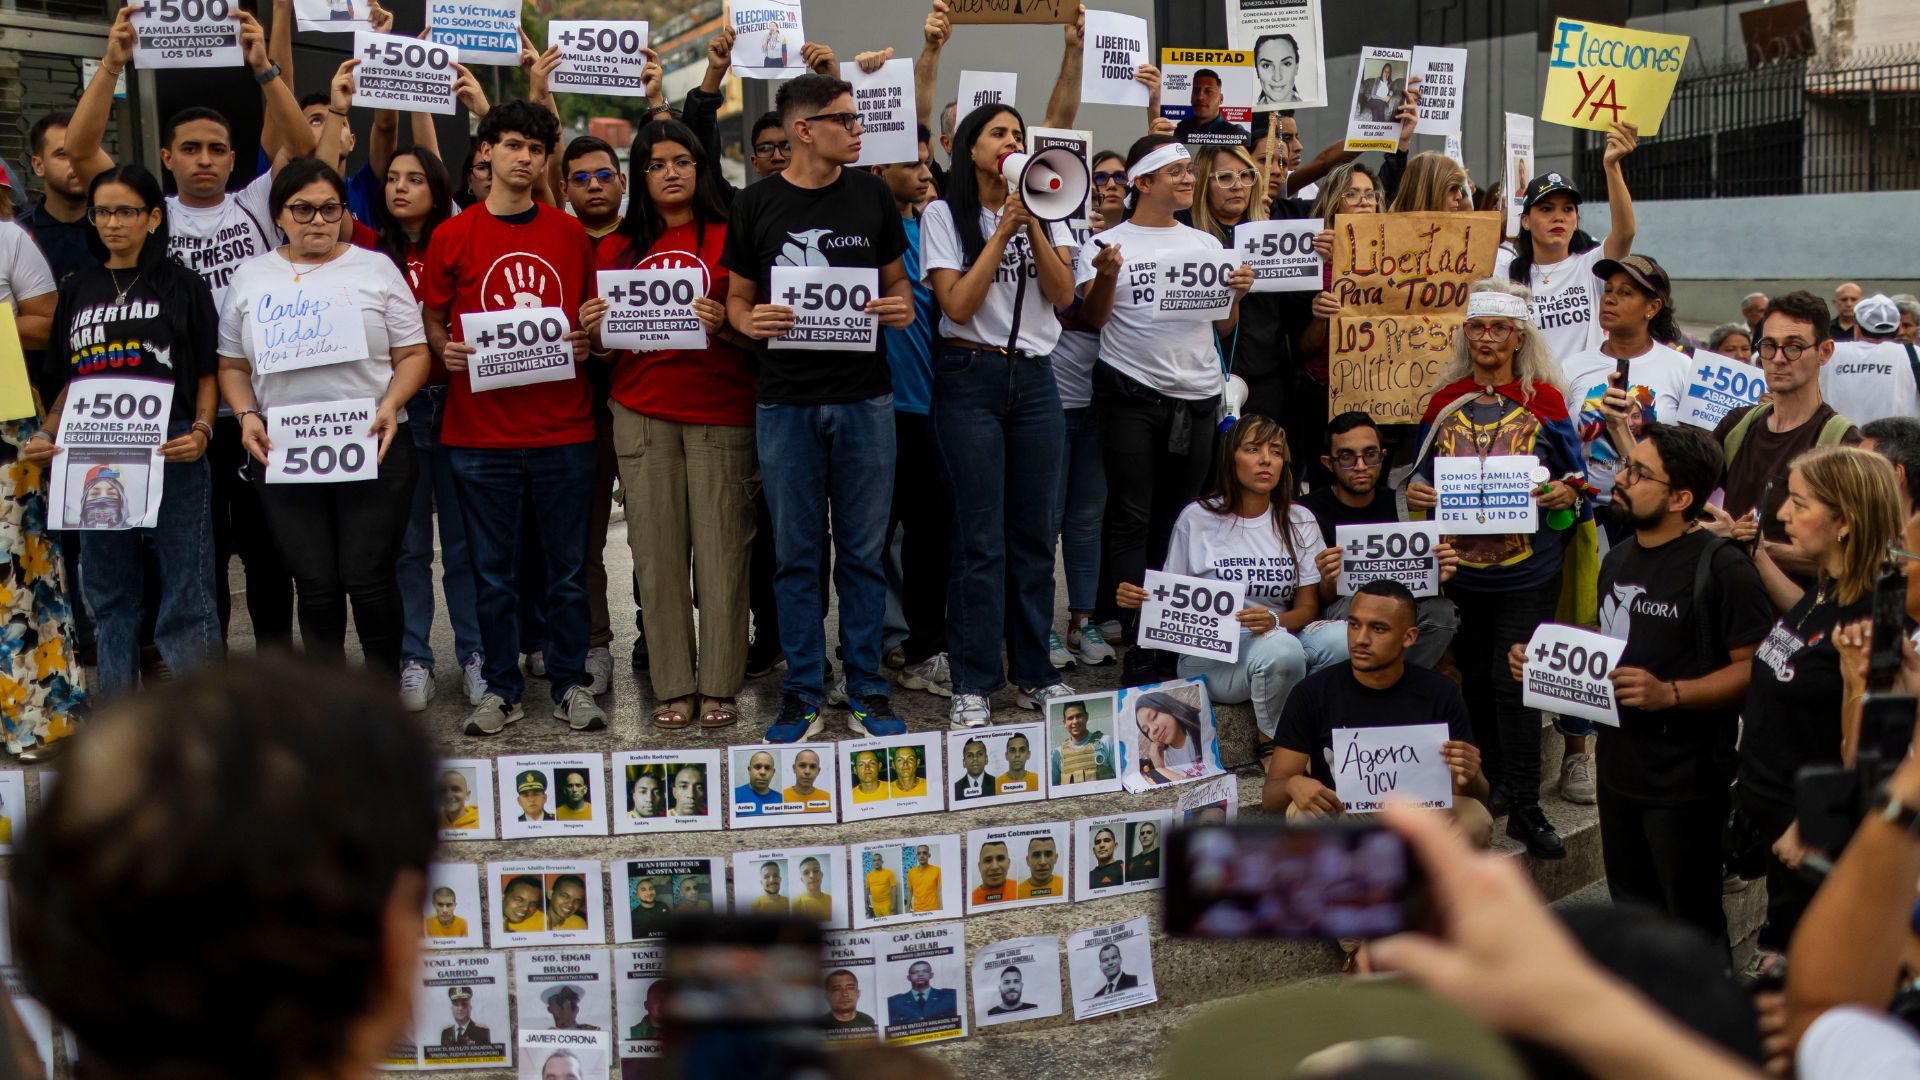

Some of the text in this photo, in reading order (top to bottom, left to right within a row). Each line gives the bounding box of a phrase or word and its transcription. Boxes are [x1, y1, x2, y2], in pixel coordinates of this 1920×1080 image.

[432, 4, 456, 15] LAS
[432, 16, 517, 31] NO SOMOS UNA
[735, 9, 797, 26] ELECCIONES YA
[138, 24, 235, 35] FAMILIAS SIGUEN
[151, 36, 225, 48] CONTANDO
[433, 31, 516, 49] TONTERÍA
[558, 27, 640, 55] +500
[1095, 34, 1141, 53] LIBERTAD
[1550, 21, 1681, 72] Elecciones
[161, 47, 213, 59] LOS DÍAS
[363, 41, 449, 71] +500
[1103, 50, 1131, 66] PARA
[1171, 51, 1245, 63] LIBERTAD
[1372, 49, 1404, 59] ABOGADA
[603, 56, 642, 66] NO HAN
[1427, 61, 1454, 73] NUESTRA
[360, 66, 451, 82] HISTORIAS SIGUEN
[573, 63, 619, 74] VUELTO A
[1101, 65, 1135, 81] TODOS
[558, 73, 639, 87] DORMIR EN PAZ
[1425, 73, 1454, 85] VOZ ES EL
[362, 78, 449, 95] MARCADAS POR
[856, 87, 902, 100] SALIMOS POR
[1418, 85, 1457, 98] GRITO DE SU
[360, 90, 450, 105] LA CÁRCEL INJUSTA
[1417, 96, 1455, 109] SILENCIO EN
[1571, 70, 1627, 123] YA
[858, 97, 902, 111] LOS QUE AÚN
[867, 110, 893, 122] SIGUEN
[1419, 110, 1450, 120] LA CELDA
[1357, 123, 1381, 131] LIBERTAD
[1244, 231, 1316, 257] +500
[1342, 222, 1476, 276] Libertad
[190, 237, 255, 270] PRESOS
[1241, 256, 1318, 266] NOMBRES ESPERAN
[1165, 262, 1234, 288] +500
[1258, 268, 1303, 279] JUSTICIA
[607, 278, 695, 307] +500
[782, 282, 872, 312] +500
[1165, 289, 1216, 299] HISTORIAS
[1217, 288, 1230, 298] DE
[1332, 276, 1385, 308] Para
[257, 289, 331, 324] Carlos
[1160, 298, 1229, 311] SUFRIMIENTO
[1538, 295, 1590, 315] PRESOS
[70, 301, 160, 333] LIBERTAD
[610, 308, 693, 319] RAZONES PARA
[608, 319, 699, 332] EXIGIR LIBERTAD
[844, 317, 872, 328] QUE
[69, 324, 106, 352] PARA
[264, 314, 334, 349] Vidal
[476, 317, 563, 350] +500
[639, 332, 671, 341] PLENA
[810, 330, 871, 342] ESPERAN
[71, 341, 142, 376] TODOS
[480, 344, 562, 365] HISTORIAS DE
[478, 355, 567, 377] SUFRIMIENTO
[1697, 365, 1766, 402] +500
[72, 393, 162, 421] +500
[280, 410, 369, 427] NOS FALTAN
[66, 422, 161, 432] RAZONES PARA
[295, 425, 353, 439] MÁS DE
[64, 433, 160, 444] SEGUIR LUCHANDO
[281, 442, 366, 476] 500
[1440, 471, 1530, 481] SOMOS FAMILIAS
[1441, 482, 1530, 492] QUE NECESITAMOS
[1441, 494, 1528, 507] SOLIDARIDAD
[1441, 511, 1469, 521] DEL
[1346, 531, 1431, 560] +500
[1214, 557, 1267, 567] LIBEREN A
[1352, 558, 1425, 572] AUSENCIAS
[1215, 569, 1243, 581] LOS
[1349, 570, 1429, 582] PESAN SOBRE
[1152, 582, 1235, 617] +500
[1161, 608, 1219, 628] PRESOS
[1159, 619, 1219, 639] POLÍTICOS
[1150, 631, 1227, 652] LEJOS DE CASA
[1534, 641, 1609, 681] +500
[1528, 668, 1609, 696] VERDADES QUE
[1529, 680, 1609, 707] INTENTAN CALLAR
[1340, 731, 1420, 781] Ágora
[1364, 770, 1398, 795] UCV
[783, 803, 803, 811] Blanco
[986, 828, 1051, 840] Jesus Colmenares
[848, 937, 871, 947] JUAN
[892, 933, 913, 943] CAP.
[831, 948, 855, 959] PEÑA
[902, 941, 939, 953] AGUILAR
[458, 957, 489, 966] PEDRO
[531, 953, 591, 963] SGTO. EDGAR
[543, 965, 580, 974] BRACHO
[633, 961, 663, 971] PEREZ
[437, 969, 478, 978] GARRIDO
[525, 1034, 597, 1045] JAVIER CORONA
